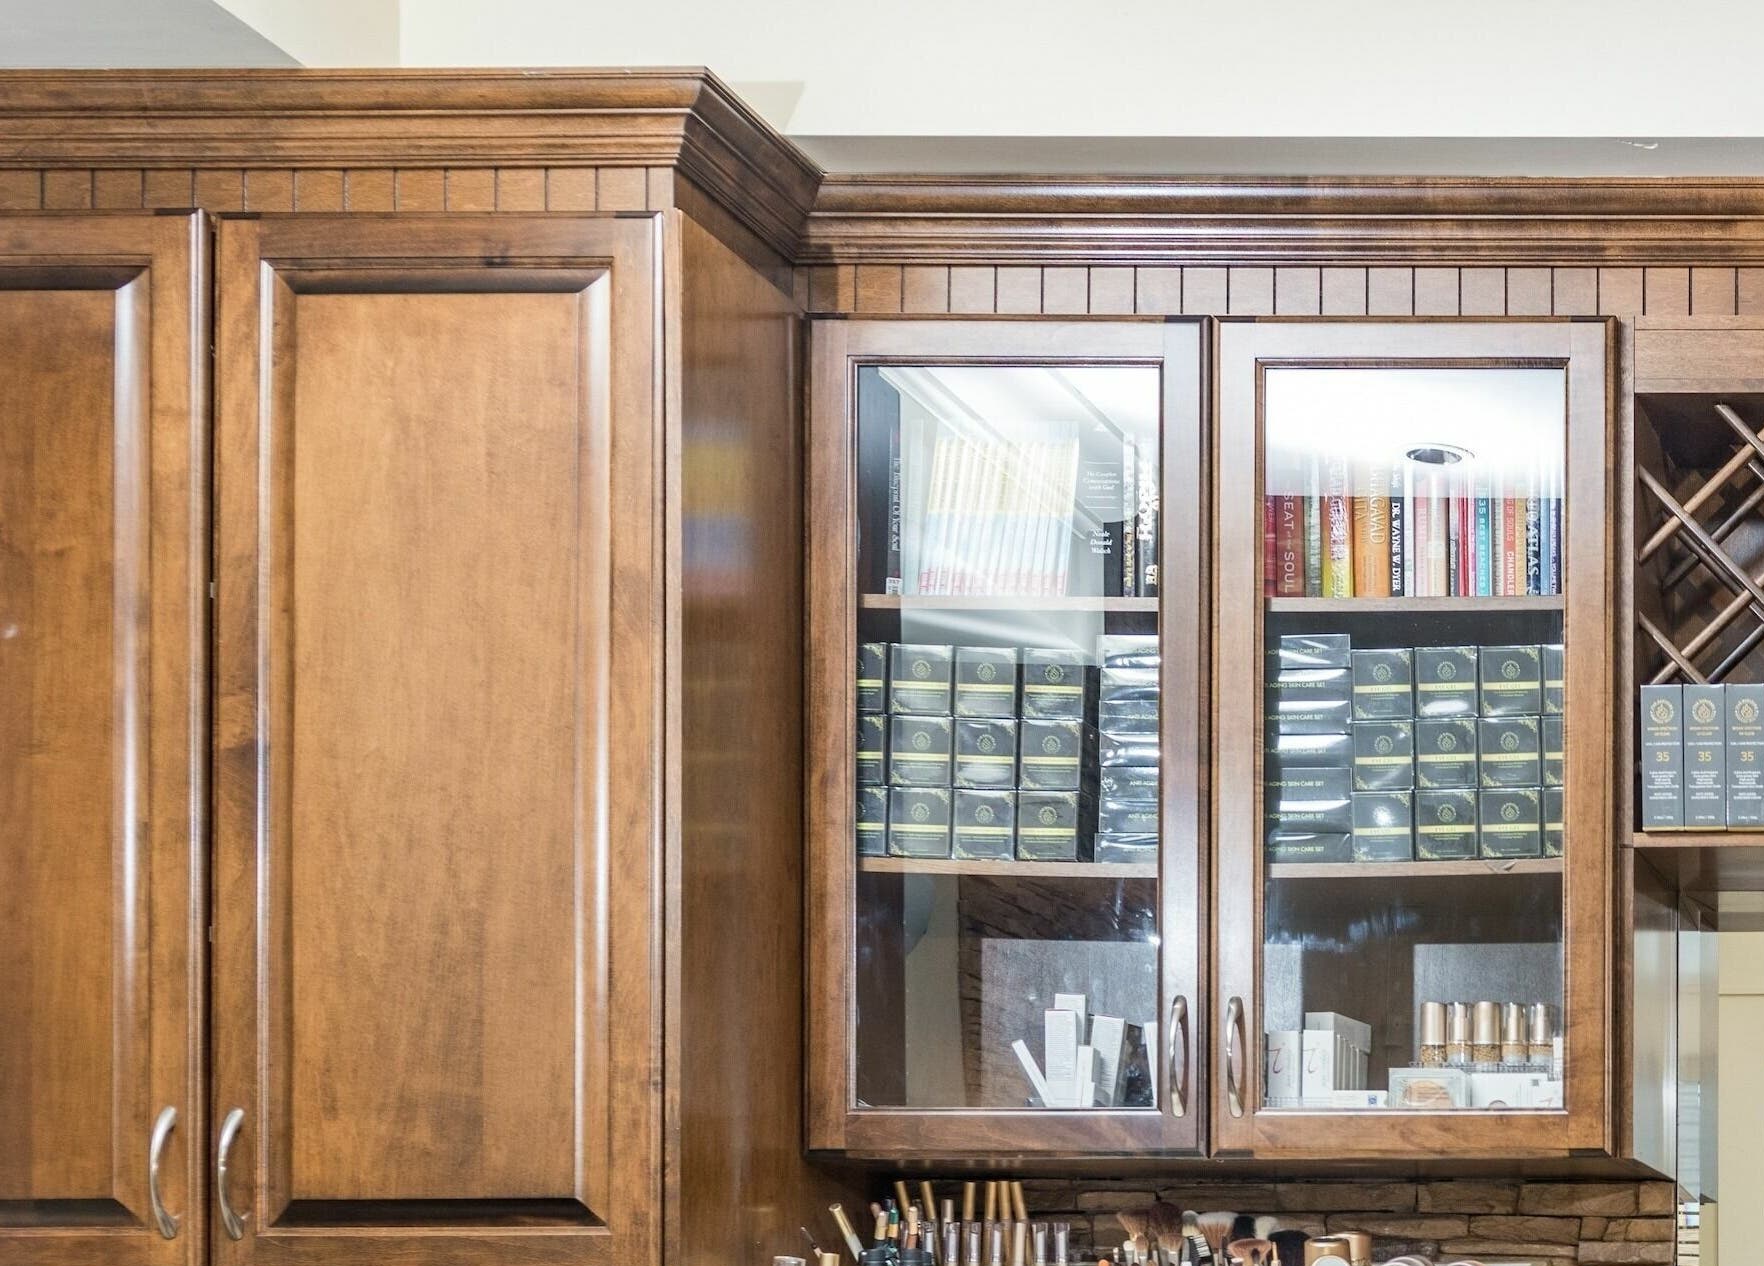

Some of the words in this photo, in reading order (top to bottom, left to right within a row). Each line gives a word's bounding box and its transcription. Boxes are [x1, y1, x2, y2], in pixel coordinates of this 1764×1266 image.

[1284, 491, 1294, 530] SEAT
[1391, 502, 1401, 518] DR.
[1391, 520, 1401, 553] WAYNE
[1284, 551, 1295, 593] SOUL
[1392, 567, 1401, 591] DYER
[1507, 551, 1515, 595] CHANDLER
[1655, 751, 1670, 762] 35
[1697, 751, 1712, 762] 35
